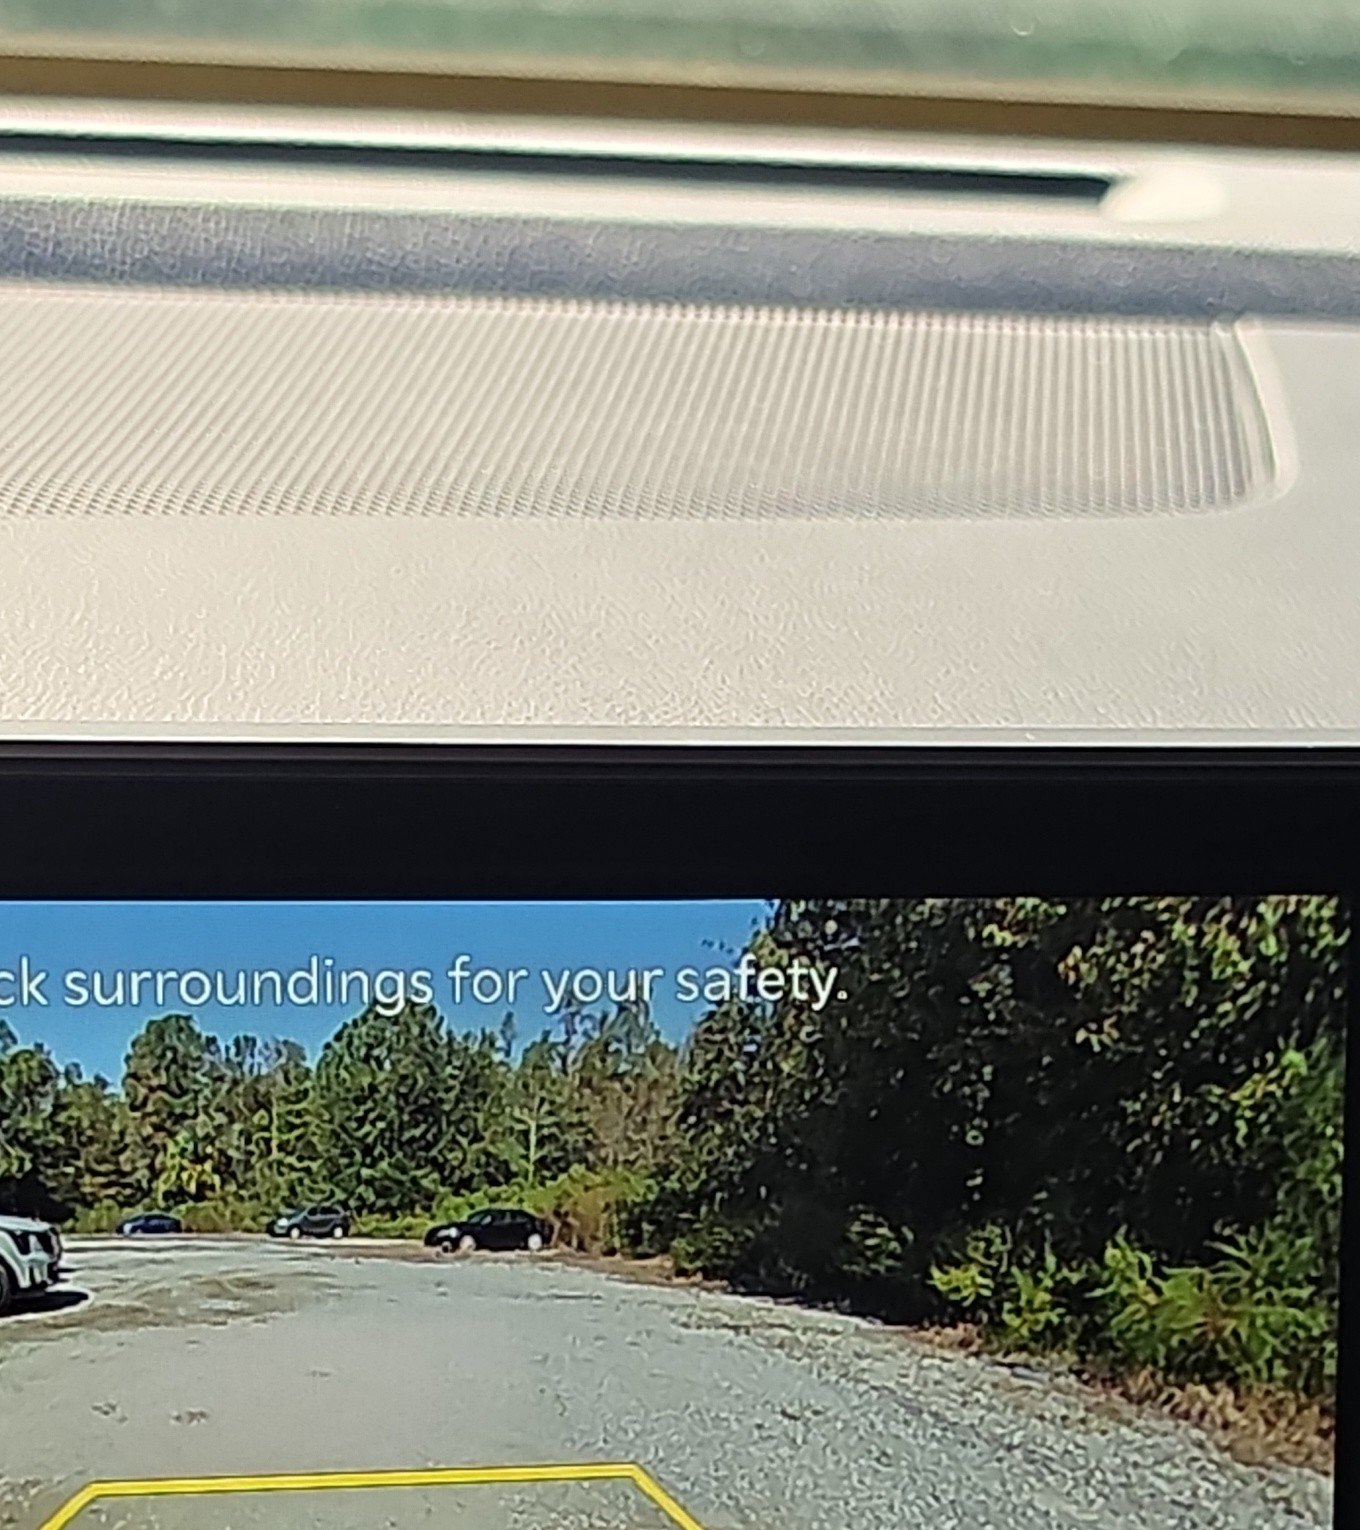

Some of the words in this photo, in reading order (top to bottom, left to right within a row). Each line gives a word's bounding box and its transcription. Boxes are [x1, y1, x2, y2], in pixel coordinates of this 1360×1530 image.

[63, 954, 434, 1017] surroundings
[447, 954, 529, 1005] for
[540, 966, 665, 1014] your
[674, 953, 849, 1012] safety.
